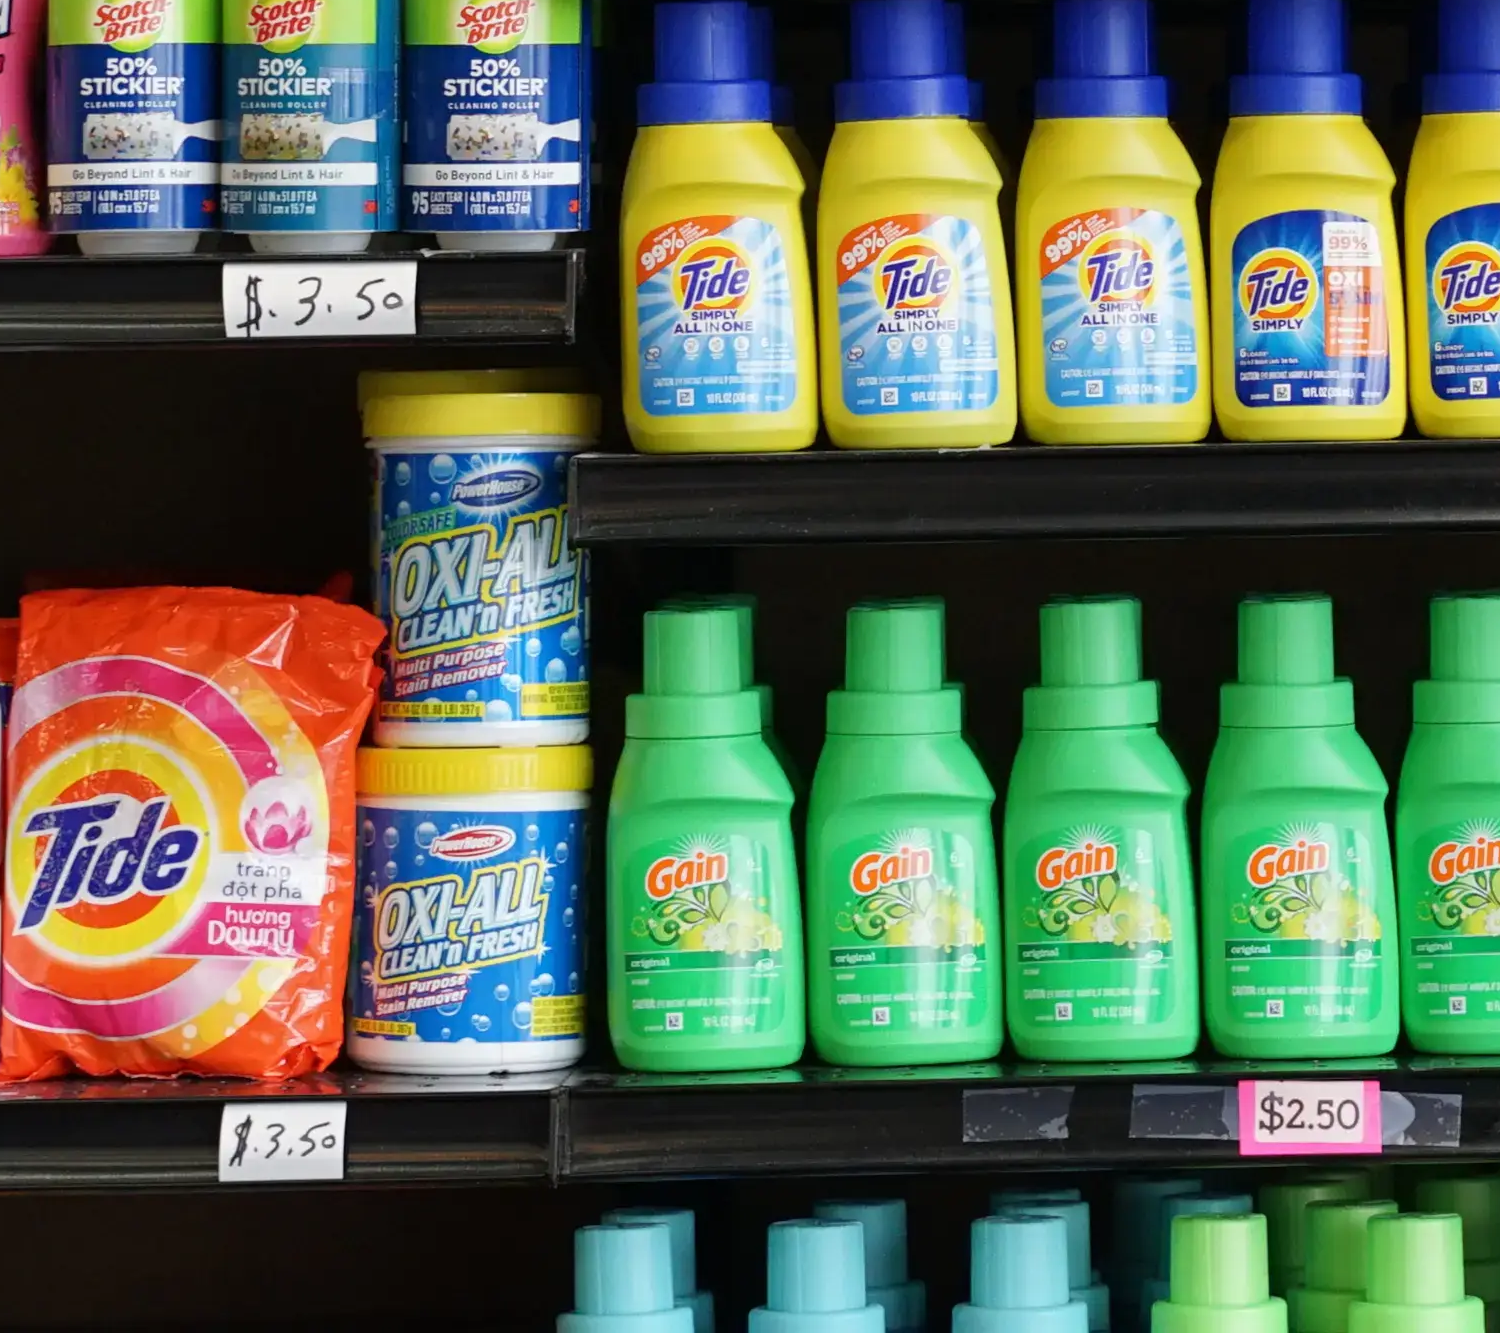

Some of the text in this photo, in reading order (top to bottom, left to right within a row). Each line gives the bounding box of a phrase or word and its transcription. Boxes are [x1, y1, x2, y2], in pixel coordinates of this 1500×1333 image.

[103, 14, 162, 44] Brite
[106, 57, 158, 76] 50%
[679, 258, 751, 311] Tide
[1085, 253, 1153, 307] Tide
[1245, 271, 1310, 317] Tide
[1252, 318, 1304, 332] SIMPLY
[16, 797, 198, 935] Tide
[647, 851, 728, 900] Gain
[1246, 839, 1328, 889] Gain
[380, 861, 544, 949] OXI-ALL
[208, 919, 294, 954] Downy
[462, 930, 539, 966] FRESH
[631, 955, 671, 969] original
[1259, 1090, 1360, 1136] $2.50
